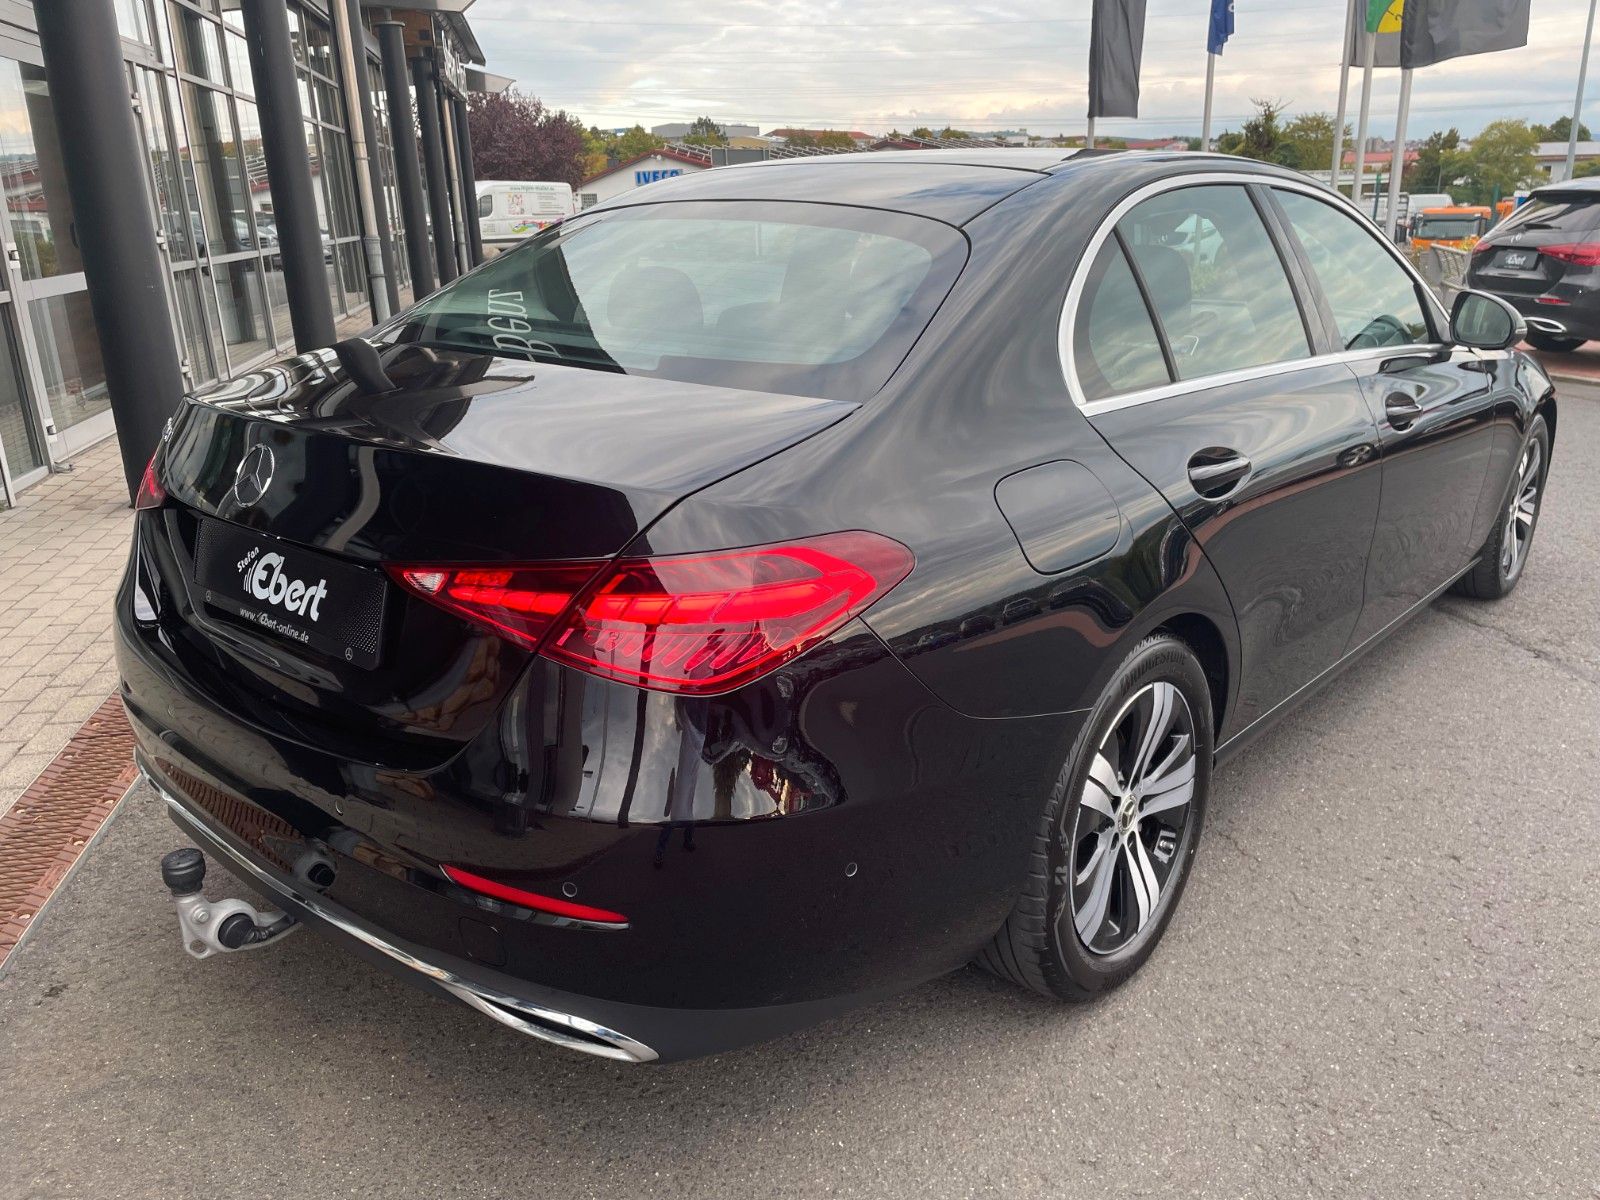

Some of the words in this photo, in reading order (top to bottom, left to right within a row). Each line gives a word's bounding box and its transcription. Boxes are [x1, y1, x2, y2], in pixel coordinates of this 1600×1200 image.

[636, 169, 681, 185] IVECO
[237, 547, 259, 572] Stefan
[252, 552, 328, 622] Ebert
